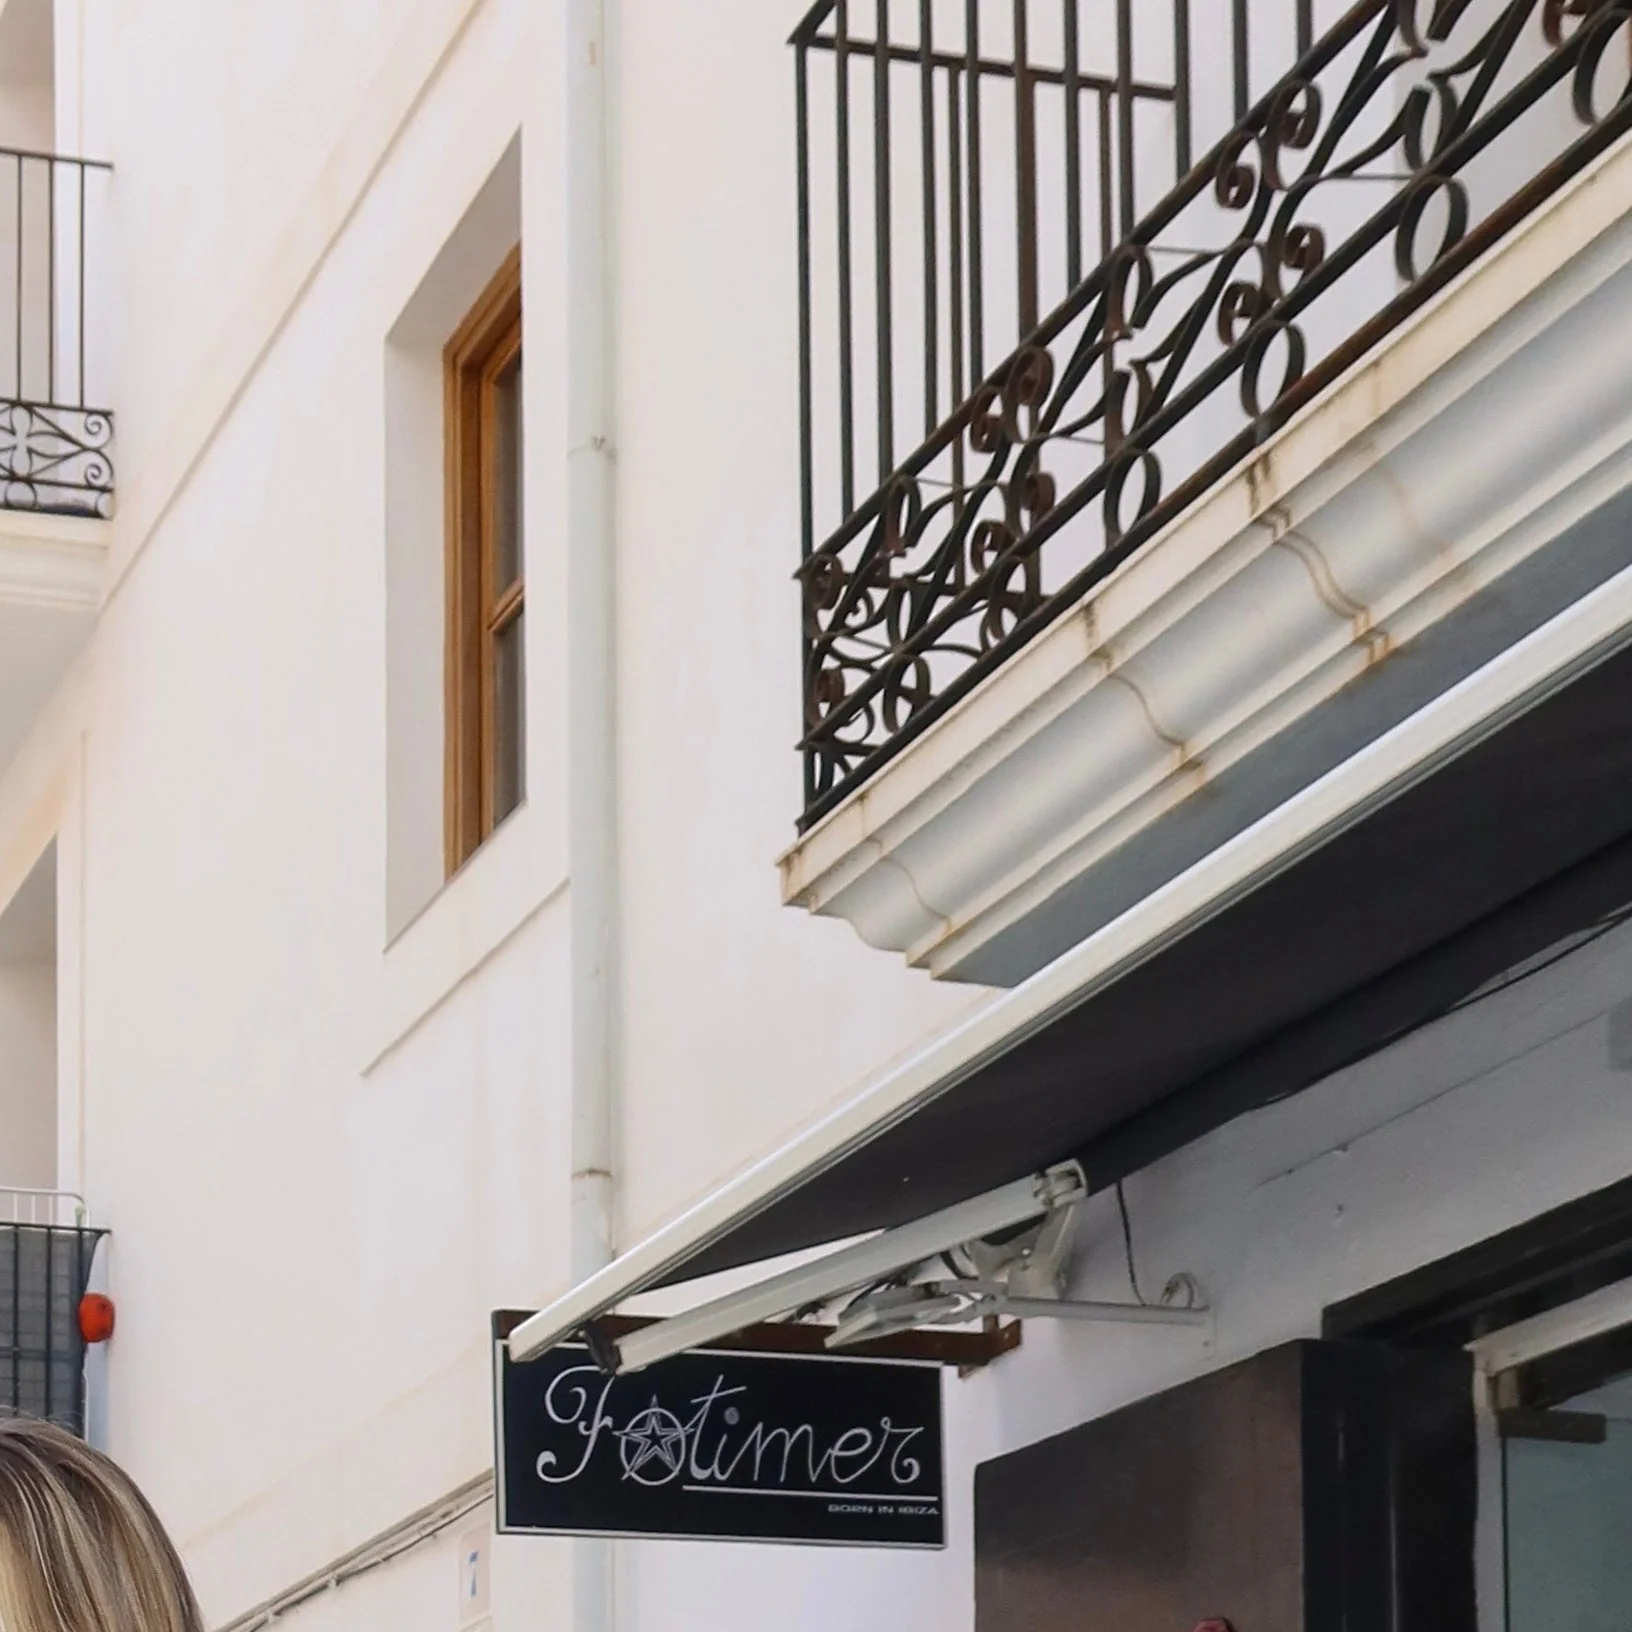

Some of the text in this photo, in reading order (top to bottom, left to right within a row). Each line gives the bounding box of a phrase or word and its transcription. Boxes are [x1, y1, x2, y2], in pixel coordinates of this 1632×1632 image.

[828, 1504, 939, 1515] BORN IN IBIZA
